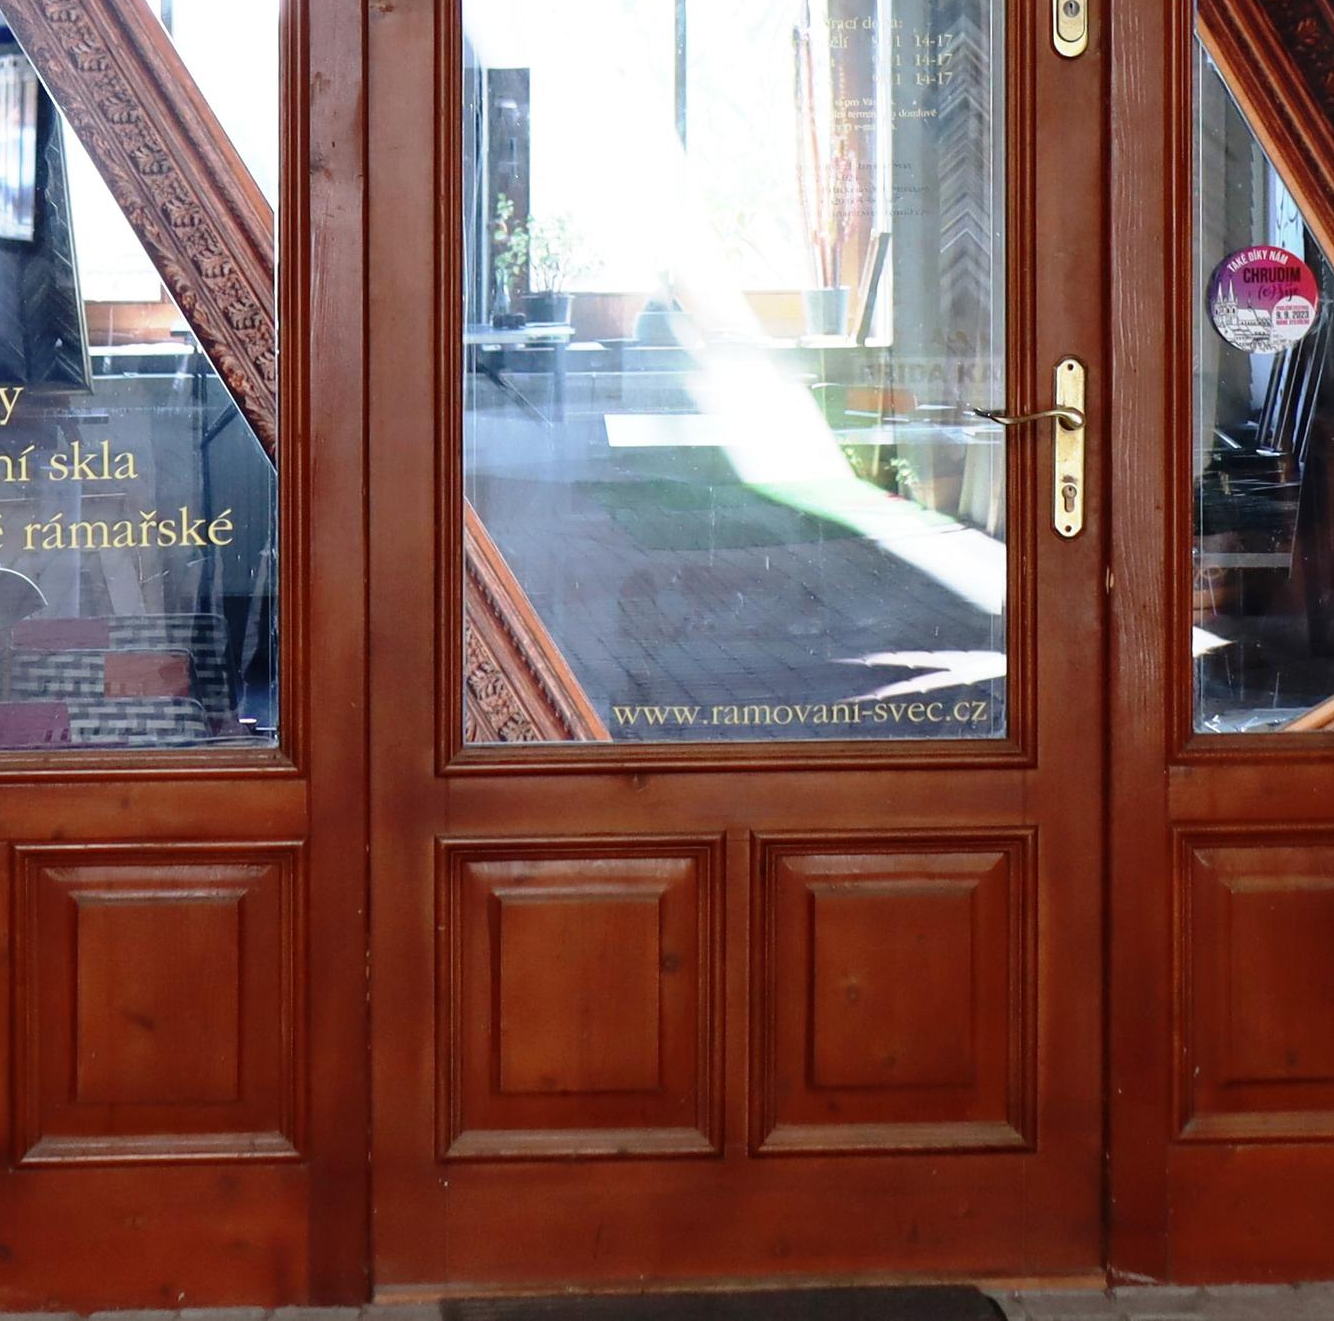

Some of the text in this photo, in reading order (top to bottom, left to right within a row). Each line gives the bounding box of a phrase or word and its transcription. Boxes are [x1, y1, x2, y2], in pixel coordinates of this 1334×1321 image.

[914, 34, 953, 48] 14-17
[914, 53, 953, 67] 14-17
[914, 72, 953, 86] 14-17
[1227, 249, 1289, 272] TAKÉ DÍKY NÁM
[1243, 266, 1301, 284] CHRUDIM
[49, 440, 138, 481] skla
[23, 507, 235, 551] rámařské
[613, 698, 988, 727] www.ramovani-svec.cz
